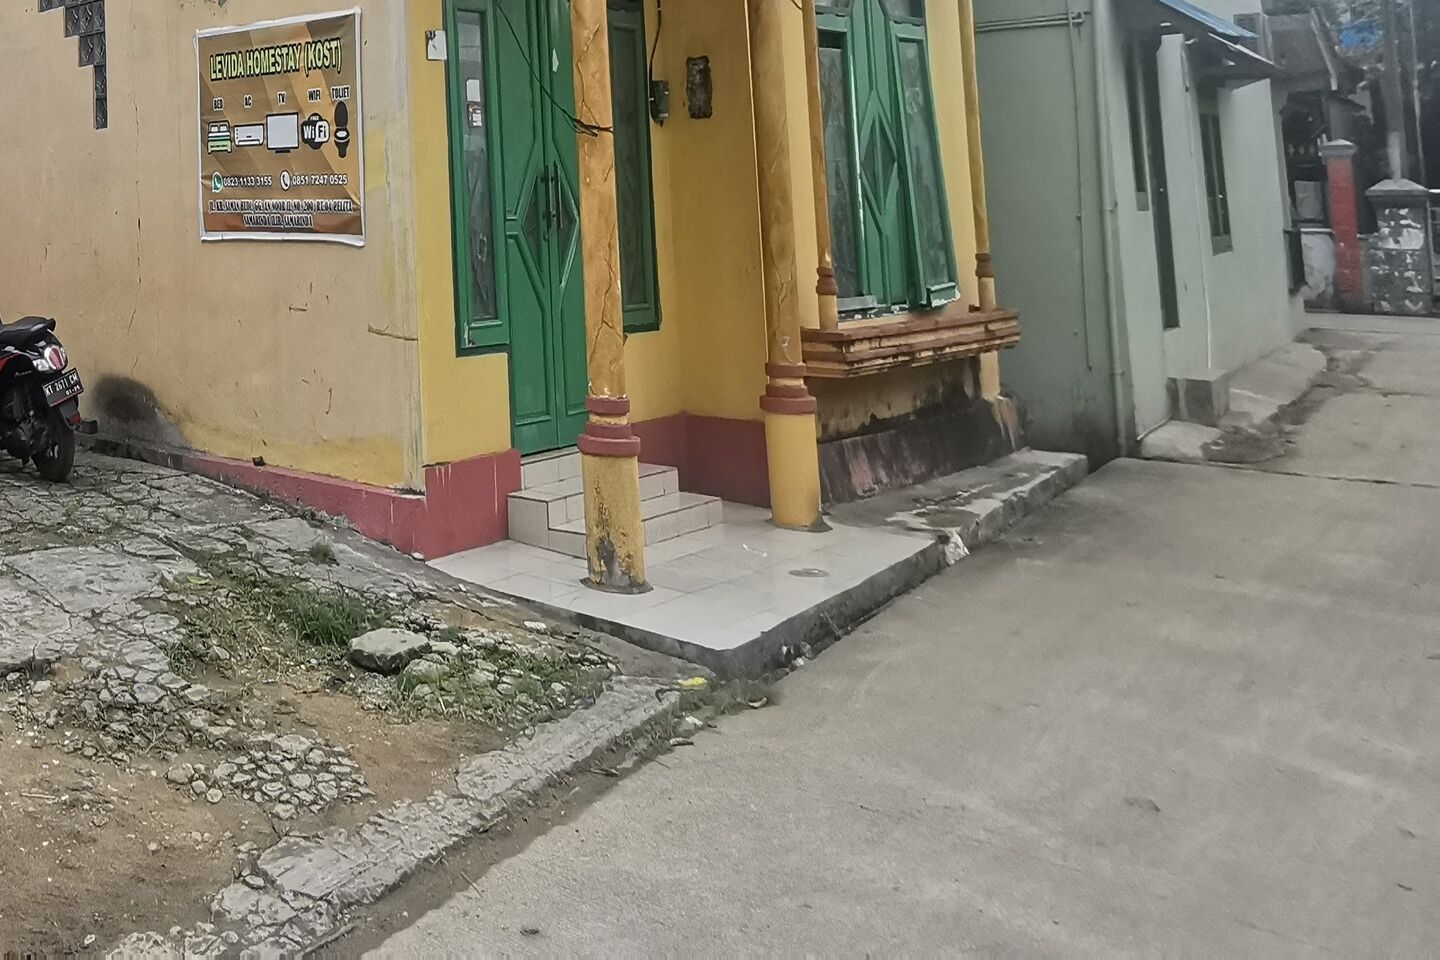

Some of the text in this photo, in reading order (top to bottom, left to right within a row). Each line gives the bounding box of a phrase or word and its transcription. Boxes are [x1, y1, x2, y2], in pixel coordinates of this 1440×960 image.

[210, 38, 342, 80] LEVIDA HOMESTAY (KOST)
[245, 96, 252, 107] AC
[278, 93, 285, 103] TV
[303, 124, 327, 140] WiFi
[240, 176, 255, 186] 1133
[257, 176, 272, 186] 3155
[292, 174, 348, 186] 0851 7247 0525
